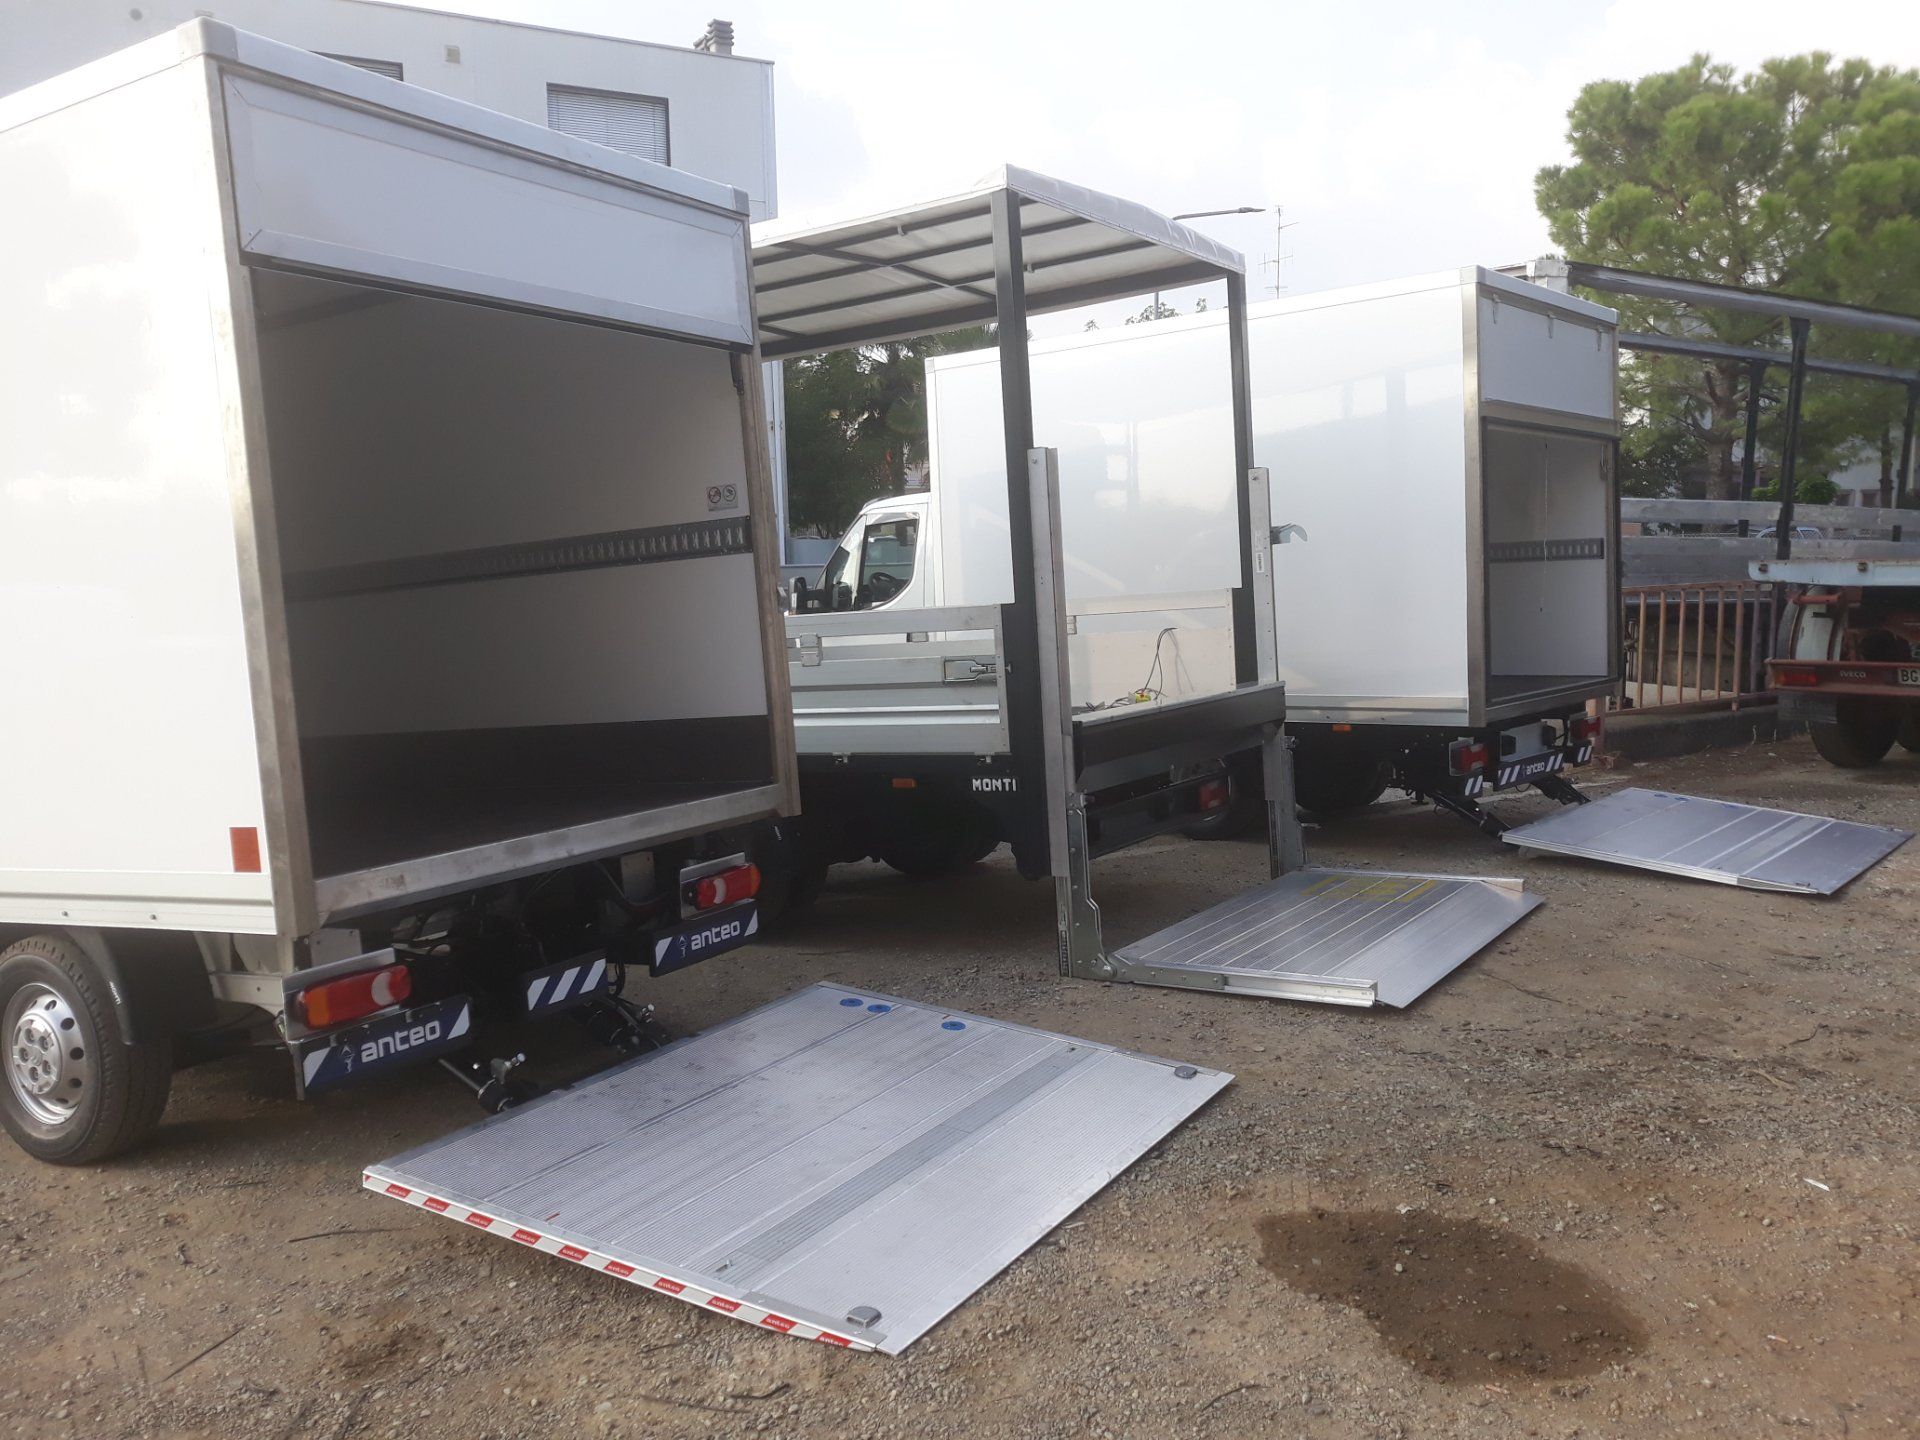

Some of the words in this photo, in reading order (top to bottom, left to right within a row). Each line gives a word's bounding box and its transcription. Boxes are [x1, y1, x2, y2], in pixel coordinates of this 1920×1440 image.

[1840, 670, 1866, 679] IVECO
[972, 778, 1017, 792] MONTI
[691, 921, 740, 951] anteo
[360, 1020, 441, 1063] anteo
